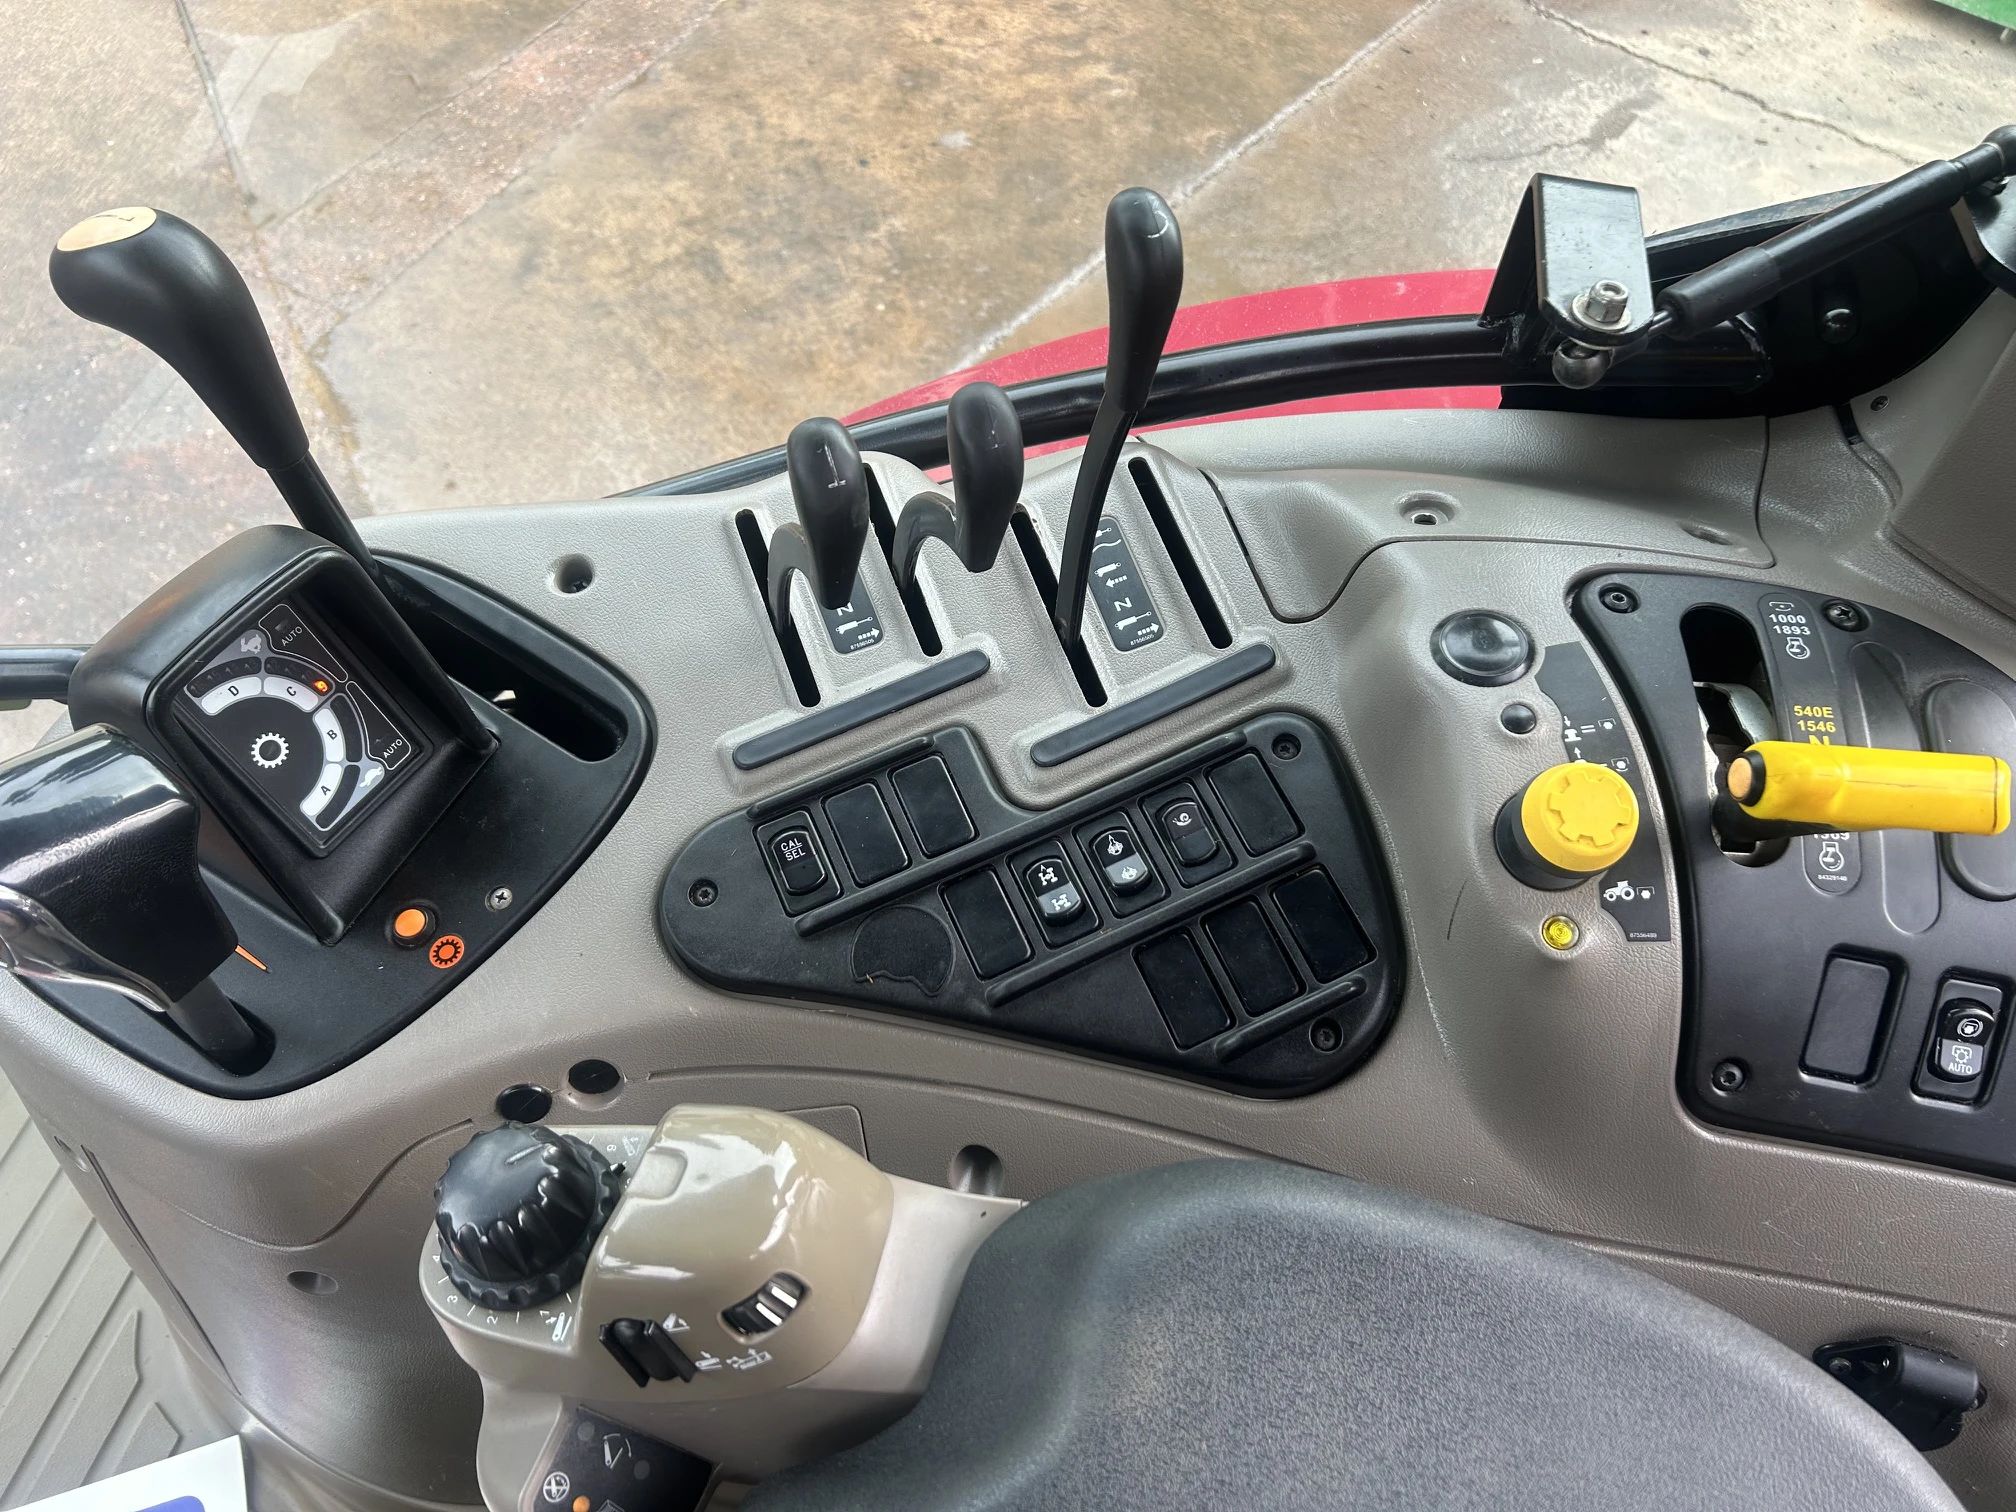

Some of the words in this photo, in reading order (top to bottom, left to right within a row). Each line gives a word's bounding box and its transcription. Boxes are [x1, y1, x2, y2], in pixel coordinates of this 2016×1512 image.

[836, 601, 855, 617] N
[1113, 596, 1133, 612] N
[1769, 613, 1807, 624] 1000
[280, 625, 303, 647] AUTO
[1773, 625, 1811, 636] 1893
[227, 685, 240, 697] D
[286, 686, 297, 697] C
[1793, 705, 1834, 718] 540E
[1797, 719, 1837, 733] 1546
[326, 729, 339, 741] B
[382, 738, 403, 759] AUTO
[320, 785, 332, 796] A
[780, 837, 802, 851] CAL
[785, 848, 806, 861] SEL
[1948, 1062, 1973, 1074] AUTO
[446, 1294, 459, 1304] 3
[486, 1315, 499, 1325] 2
